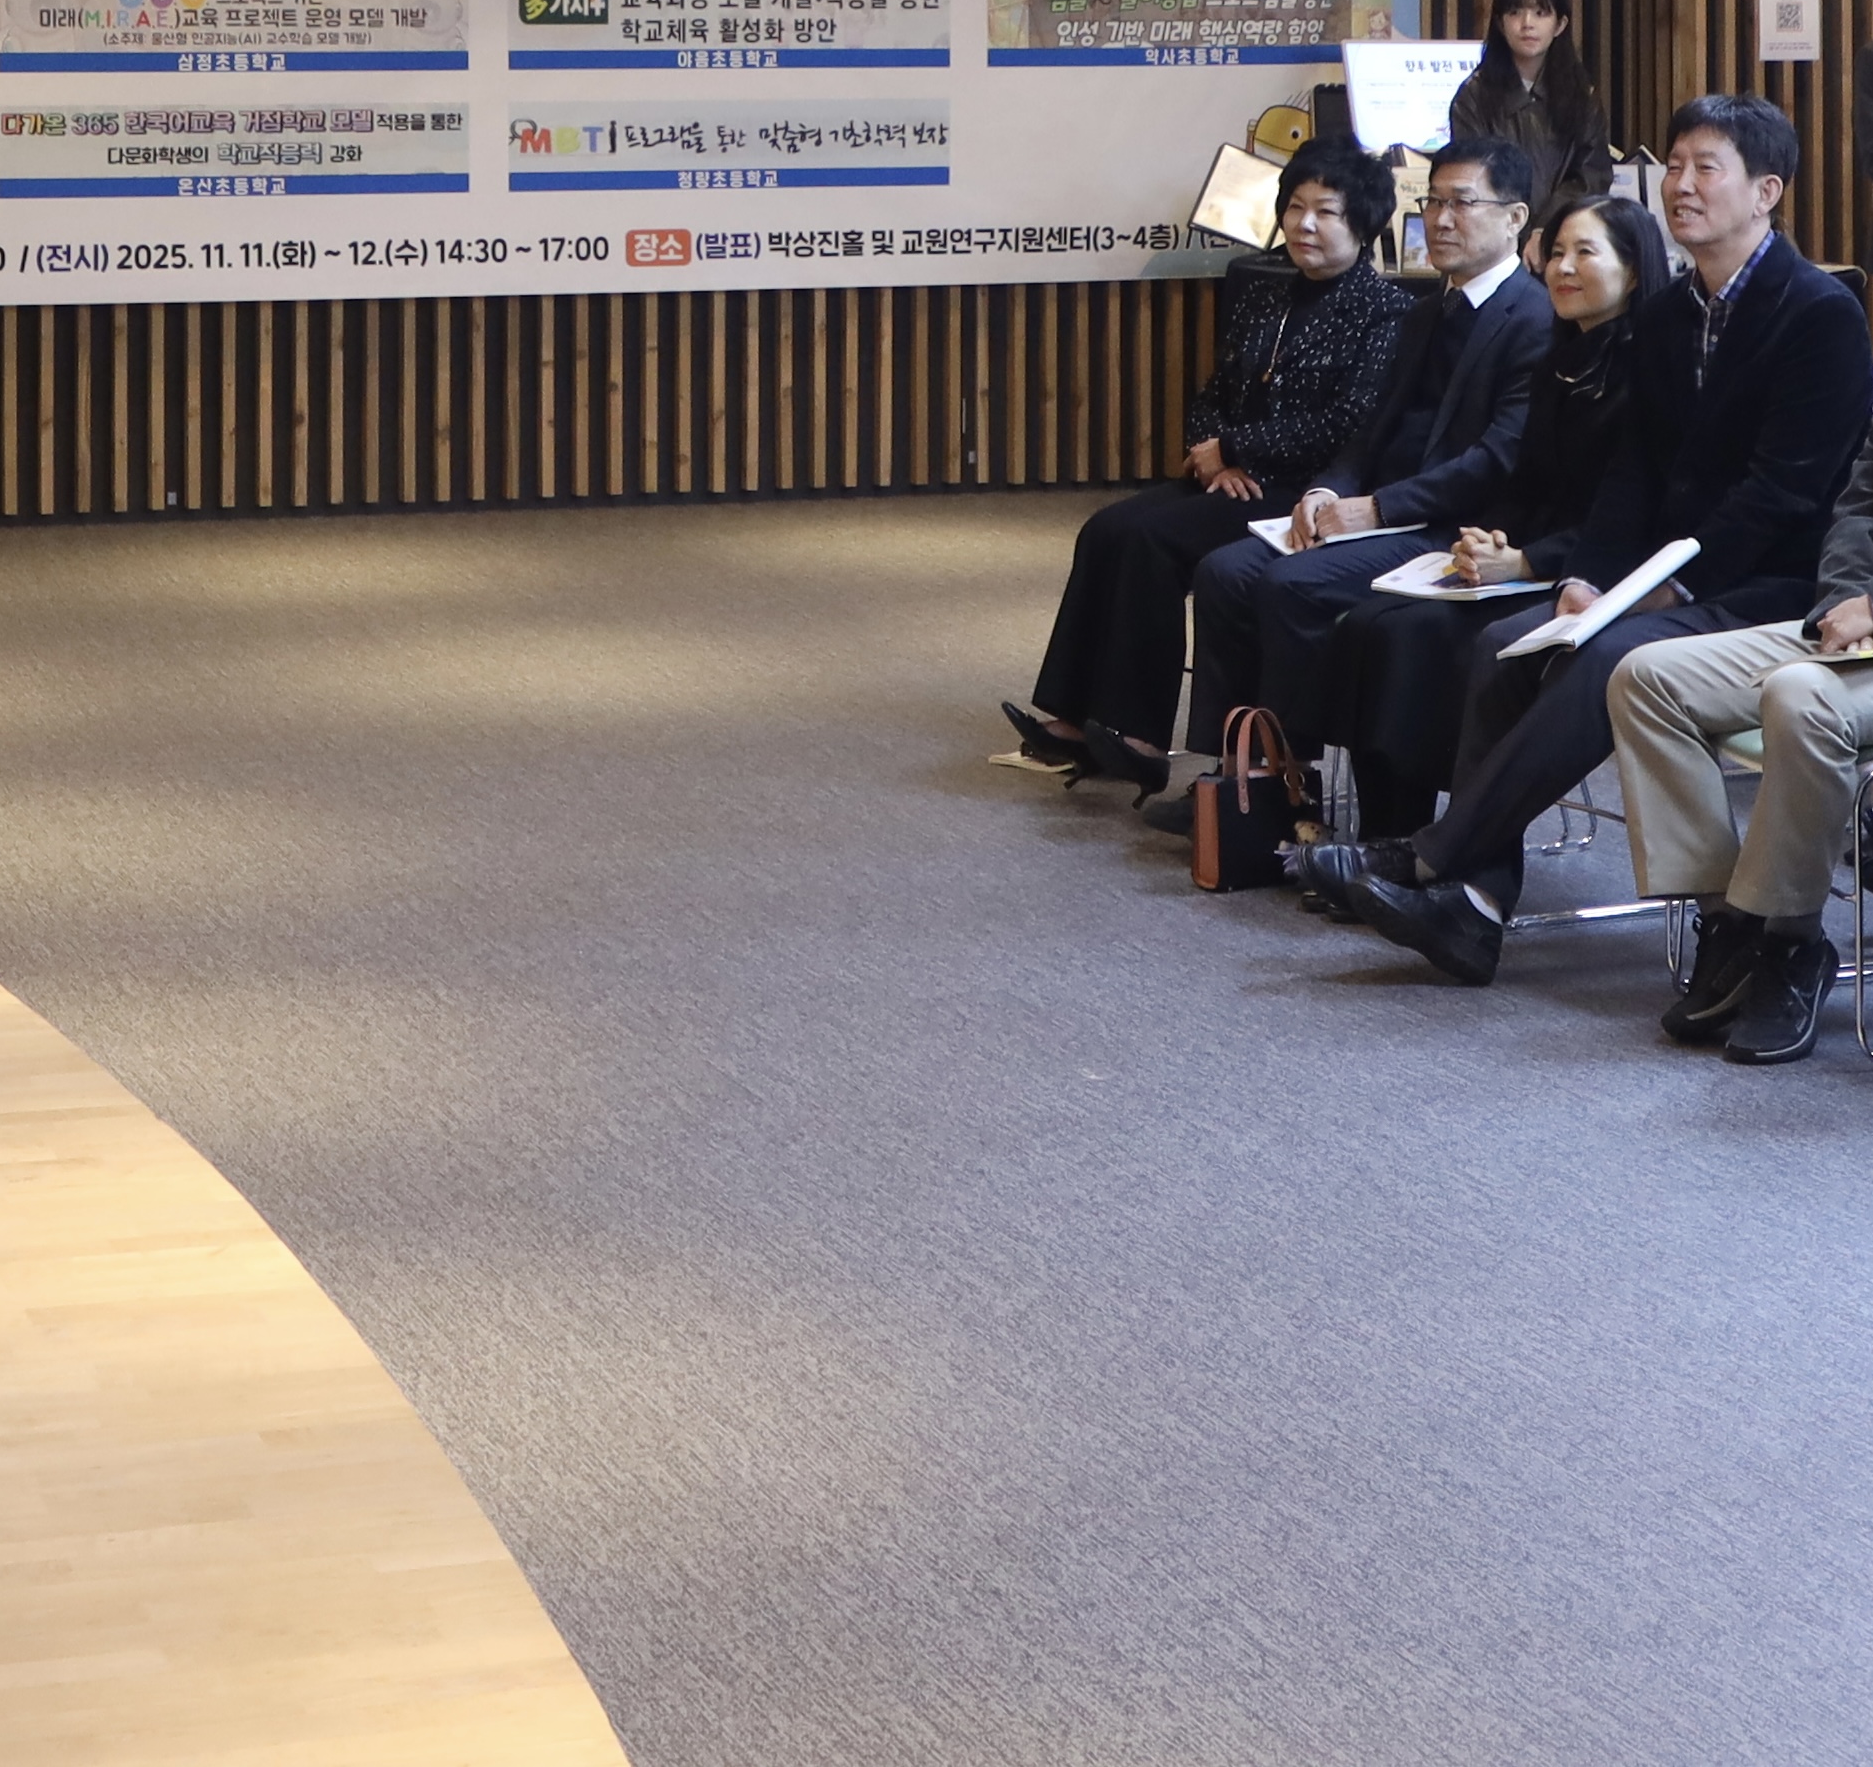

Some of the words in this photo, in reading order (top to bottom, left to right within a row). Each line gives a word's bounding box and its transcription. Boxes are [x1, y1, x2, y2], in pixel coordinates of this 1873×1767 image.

[226, 9, 297, 29] 프로젝트
[305, 9, 342, 29] 운영
[348, 9, 384, 29] 모델
[390, 9, 427, 29] 개발
[621, 18, 709, 43] 학교체육
[719, 18, 784, 43] 활성화
[794, 18, 837, 43] 방안
[1057, 21, 1098, 47] 인성
[1103, 21, 1145, 47] 기반
[1151, 21, 1193, 44] 미래
[1200, 19, 1283, 46] 핵심역량
[1288, 19, 1325, 44] 함양
[177, 53, 286, 72] 삼정초등학교
[677, 51, 778, 68] 야음초등학교
[1145, 48, 1239, 65] 약사초등학교
[1, 113, 66, 136] 다가온
[71, 113, 119, 135] 365
[124, 111, 235, 135] 한국어교육
[244, 110, 326, 134] 거점학교
[330, 109, 374, 133] 모델
[376, 112, 427, 132] 적용을
[430, 112, 463, 132] 통한
[625, 122, 707, 153] 프로그램을
[716, 124, 746, 153] 통한
[760, 121, 822, 153] 맞춤형
[829, 121, 905, 148] 기초학력
[913, 122, 948, 145] 보장
[107, 145, 208, 165] 다문화학생의
[217, 142, 322, 165] 학교적응력
[330, 145, 362, 163] 강화
[177, 177, 286, 197] 온산초등학교
[678, 170, 779, 187] 청량초등학교
[632, 234, 684, 261] 장소
[695, 231, 761, 259] (발표)
[767, 228, 864, 258] 박상진홀
[872, 228, 893, 255] 및
[900, 225, 1180, 257] 교원연구지원센터(3~4층)
[36, 244, 109, 274] (전시)
[117, 244, 194, 270] 2025.
[201, 244, 233, 268] 11.
[239, 240, 316, 270] 11.(화)
[347, 238, 428, 267] 12.(수)
[435, 238, 507, 264] 14:30
[539, 236, 609, 262] 17:00
